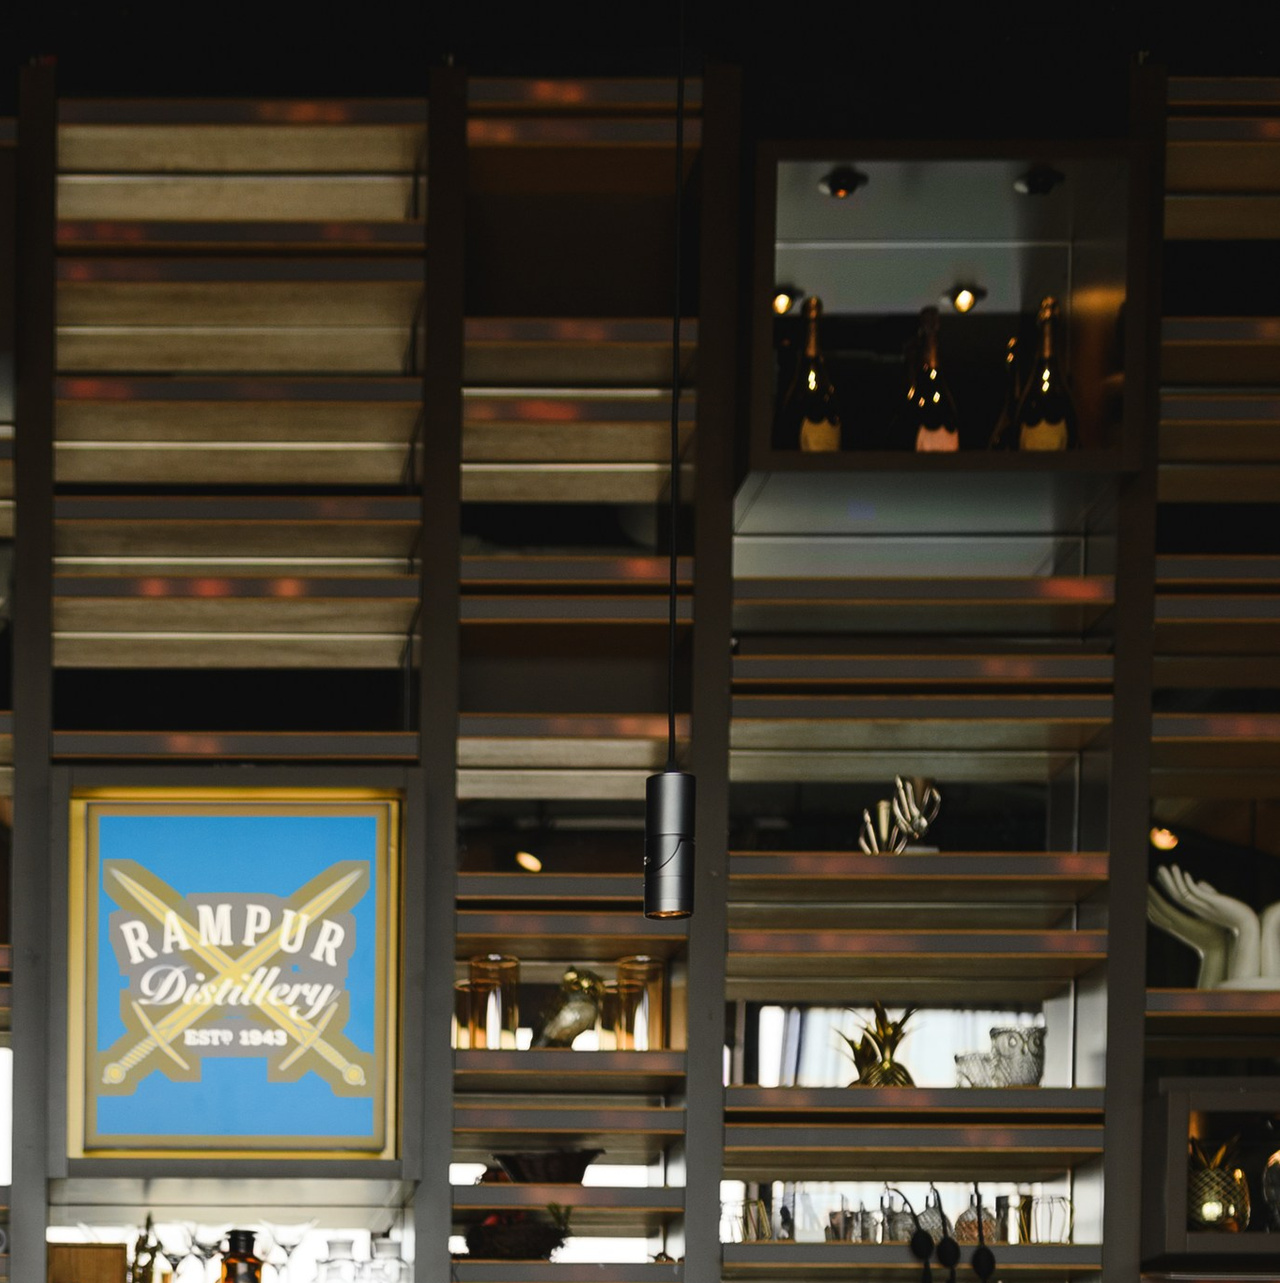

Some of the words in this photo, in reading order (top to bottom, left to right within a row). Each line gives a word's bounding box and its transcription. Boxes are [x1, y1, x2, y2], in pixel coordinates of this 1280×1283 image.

[119, 903, 346, 967] RAMPUR
[137, 963, 341, 1021] Distillery
[239, 1028, 288, 1047] 1943
